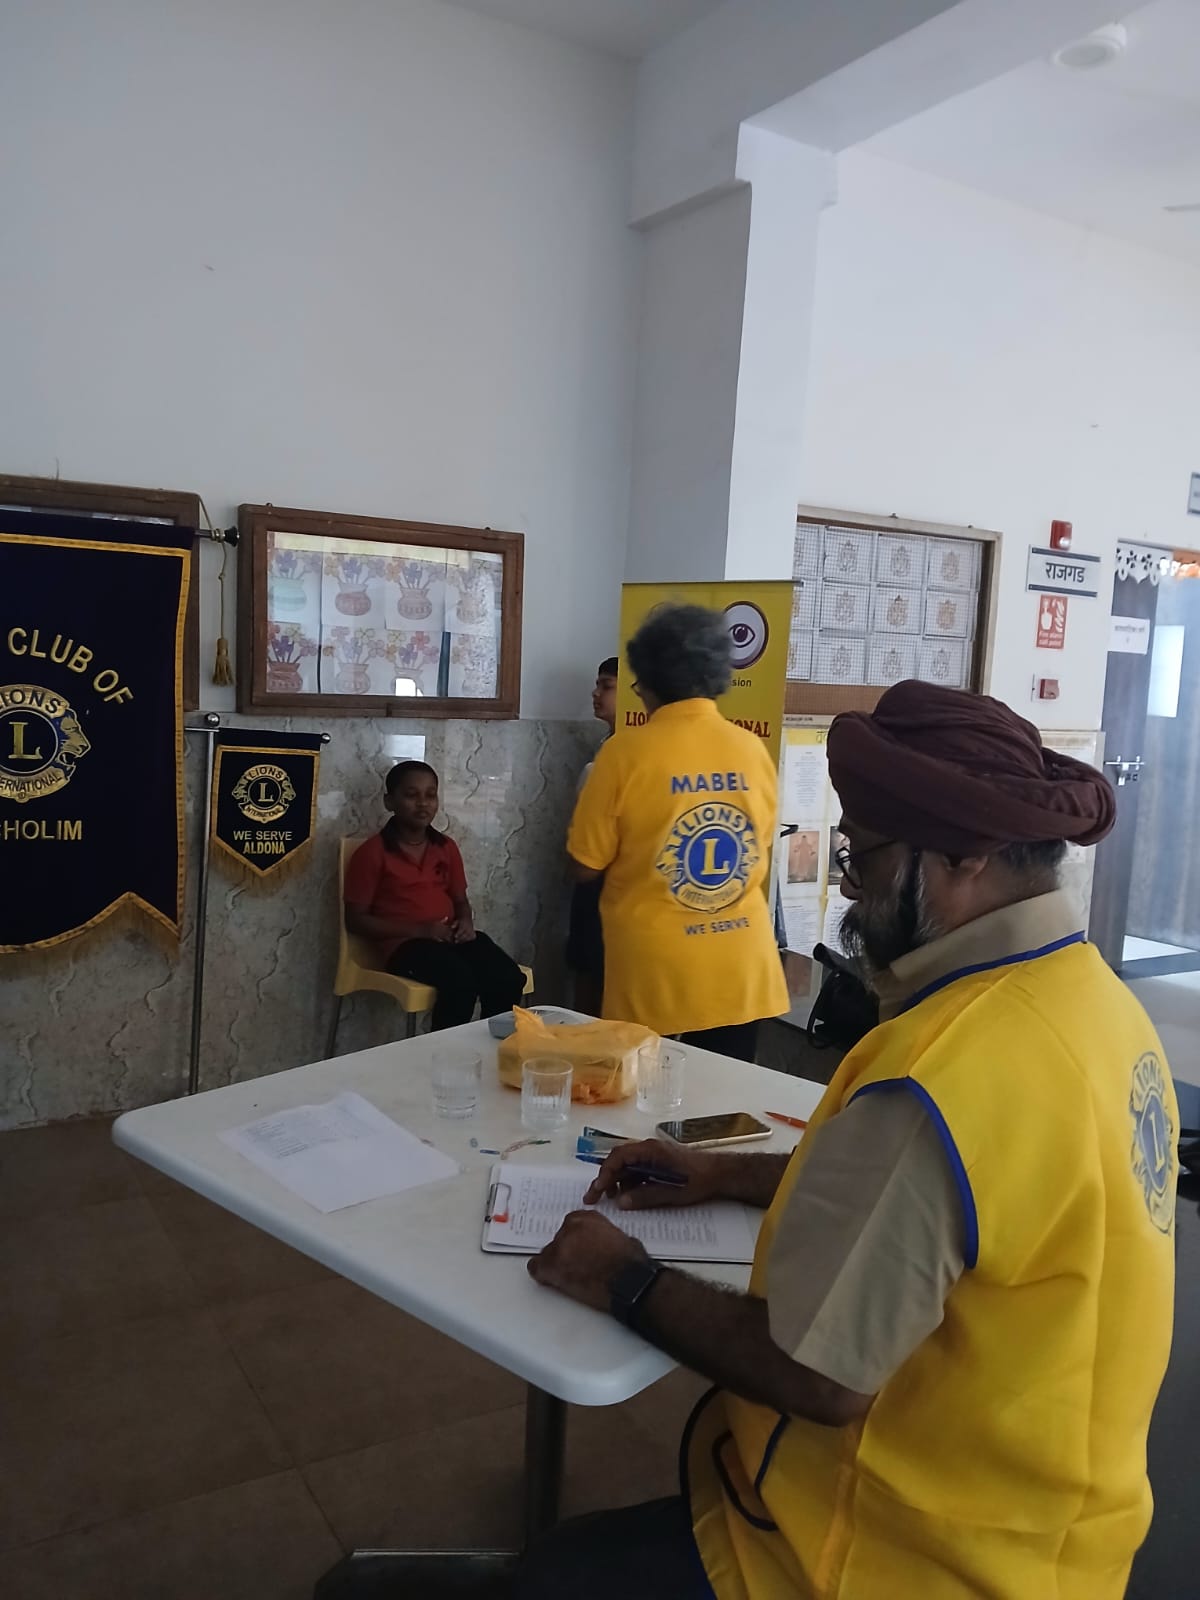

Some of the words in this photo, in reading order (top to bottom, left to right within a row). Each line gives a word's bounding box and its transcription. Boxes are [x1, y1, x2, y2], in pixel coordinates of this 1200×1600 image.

[1045, 562, 1086, 583] राजगड
[8, 628, 93, 673] CLUB
[93, 669, 134, 705] OF
[731, 677, 752, 688] sion
[8, 721, 43, 760] L
[0, 771, 63, 792] ERNATIONAL
[248, 766, 283, 779] LIONS
[258, 782, 275, 802] L
[671, 772, 749, 795] MABEL
[681, 807, 744, 832] LIONS
[0, 820, 82, 840] HOLIM
[233, 831, 252, 841] WE
[255, 831, 293, 841] SERVE
[243, 841, 286, 854] ALDONA
[701, 838, 730, 876] L
[685, 924, 706, 936] WE
[711, 917, 750, 933] SERVE
